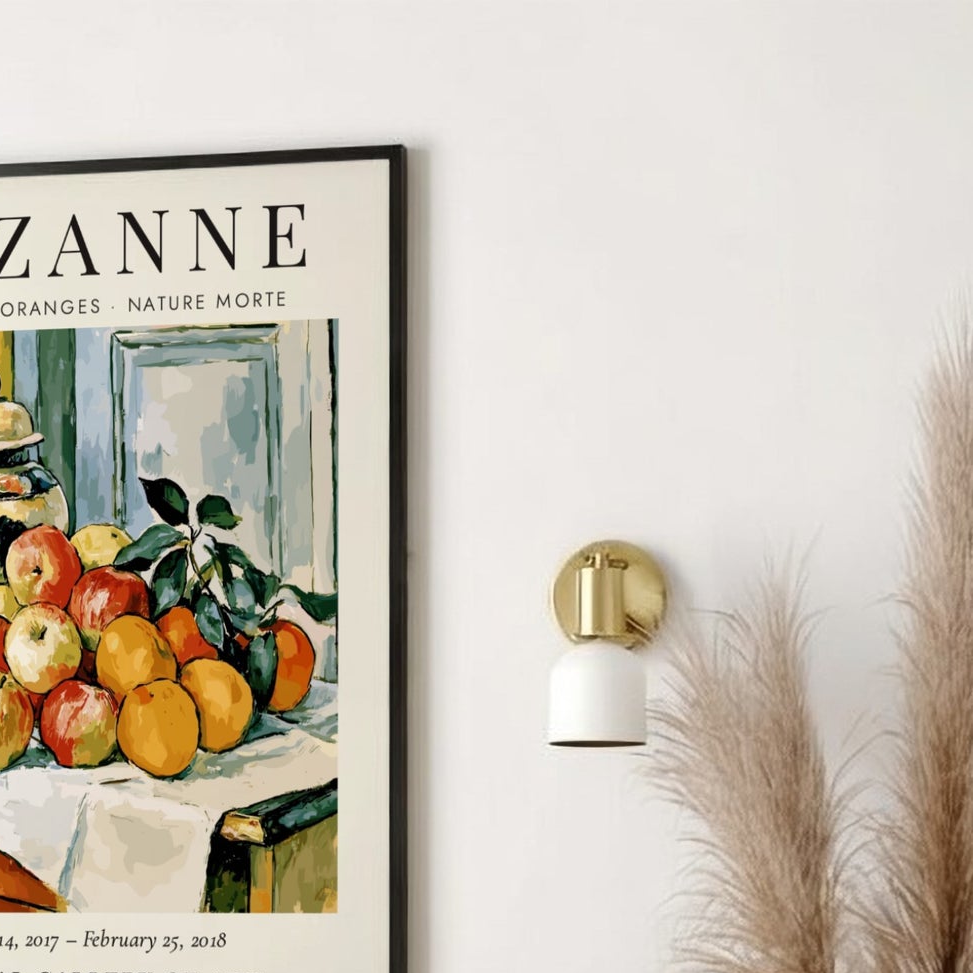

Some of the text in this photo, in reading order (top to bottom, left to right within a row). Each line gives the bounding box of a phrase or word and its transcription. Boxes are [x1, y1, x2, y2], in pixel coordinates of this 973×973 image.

[0, 298, 100, 317] ORANGES
[129, 294, 204, 312] NATURE
[216, 291, 285, 309] MORTE
[25, 936, 59, 953] 2017
[83, 929, 157, 954] February
[162, 936, 183, 953] 25,
[191, 932, 226, 948] 2018
